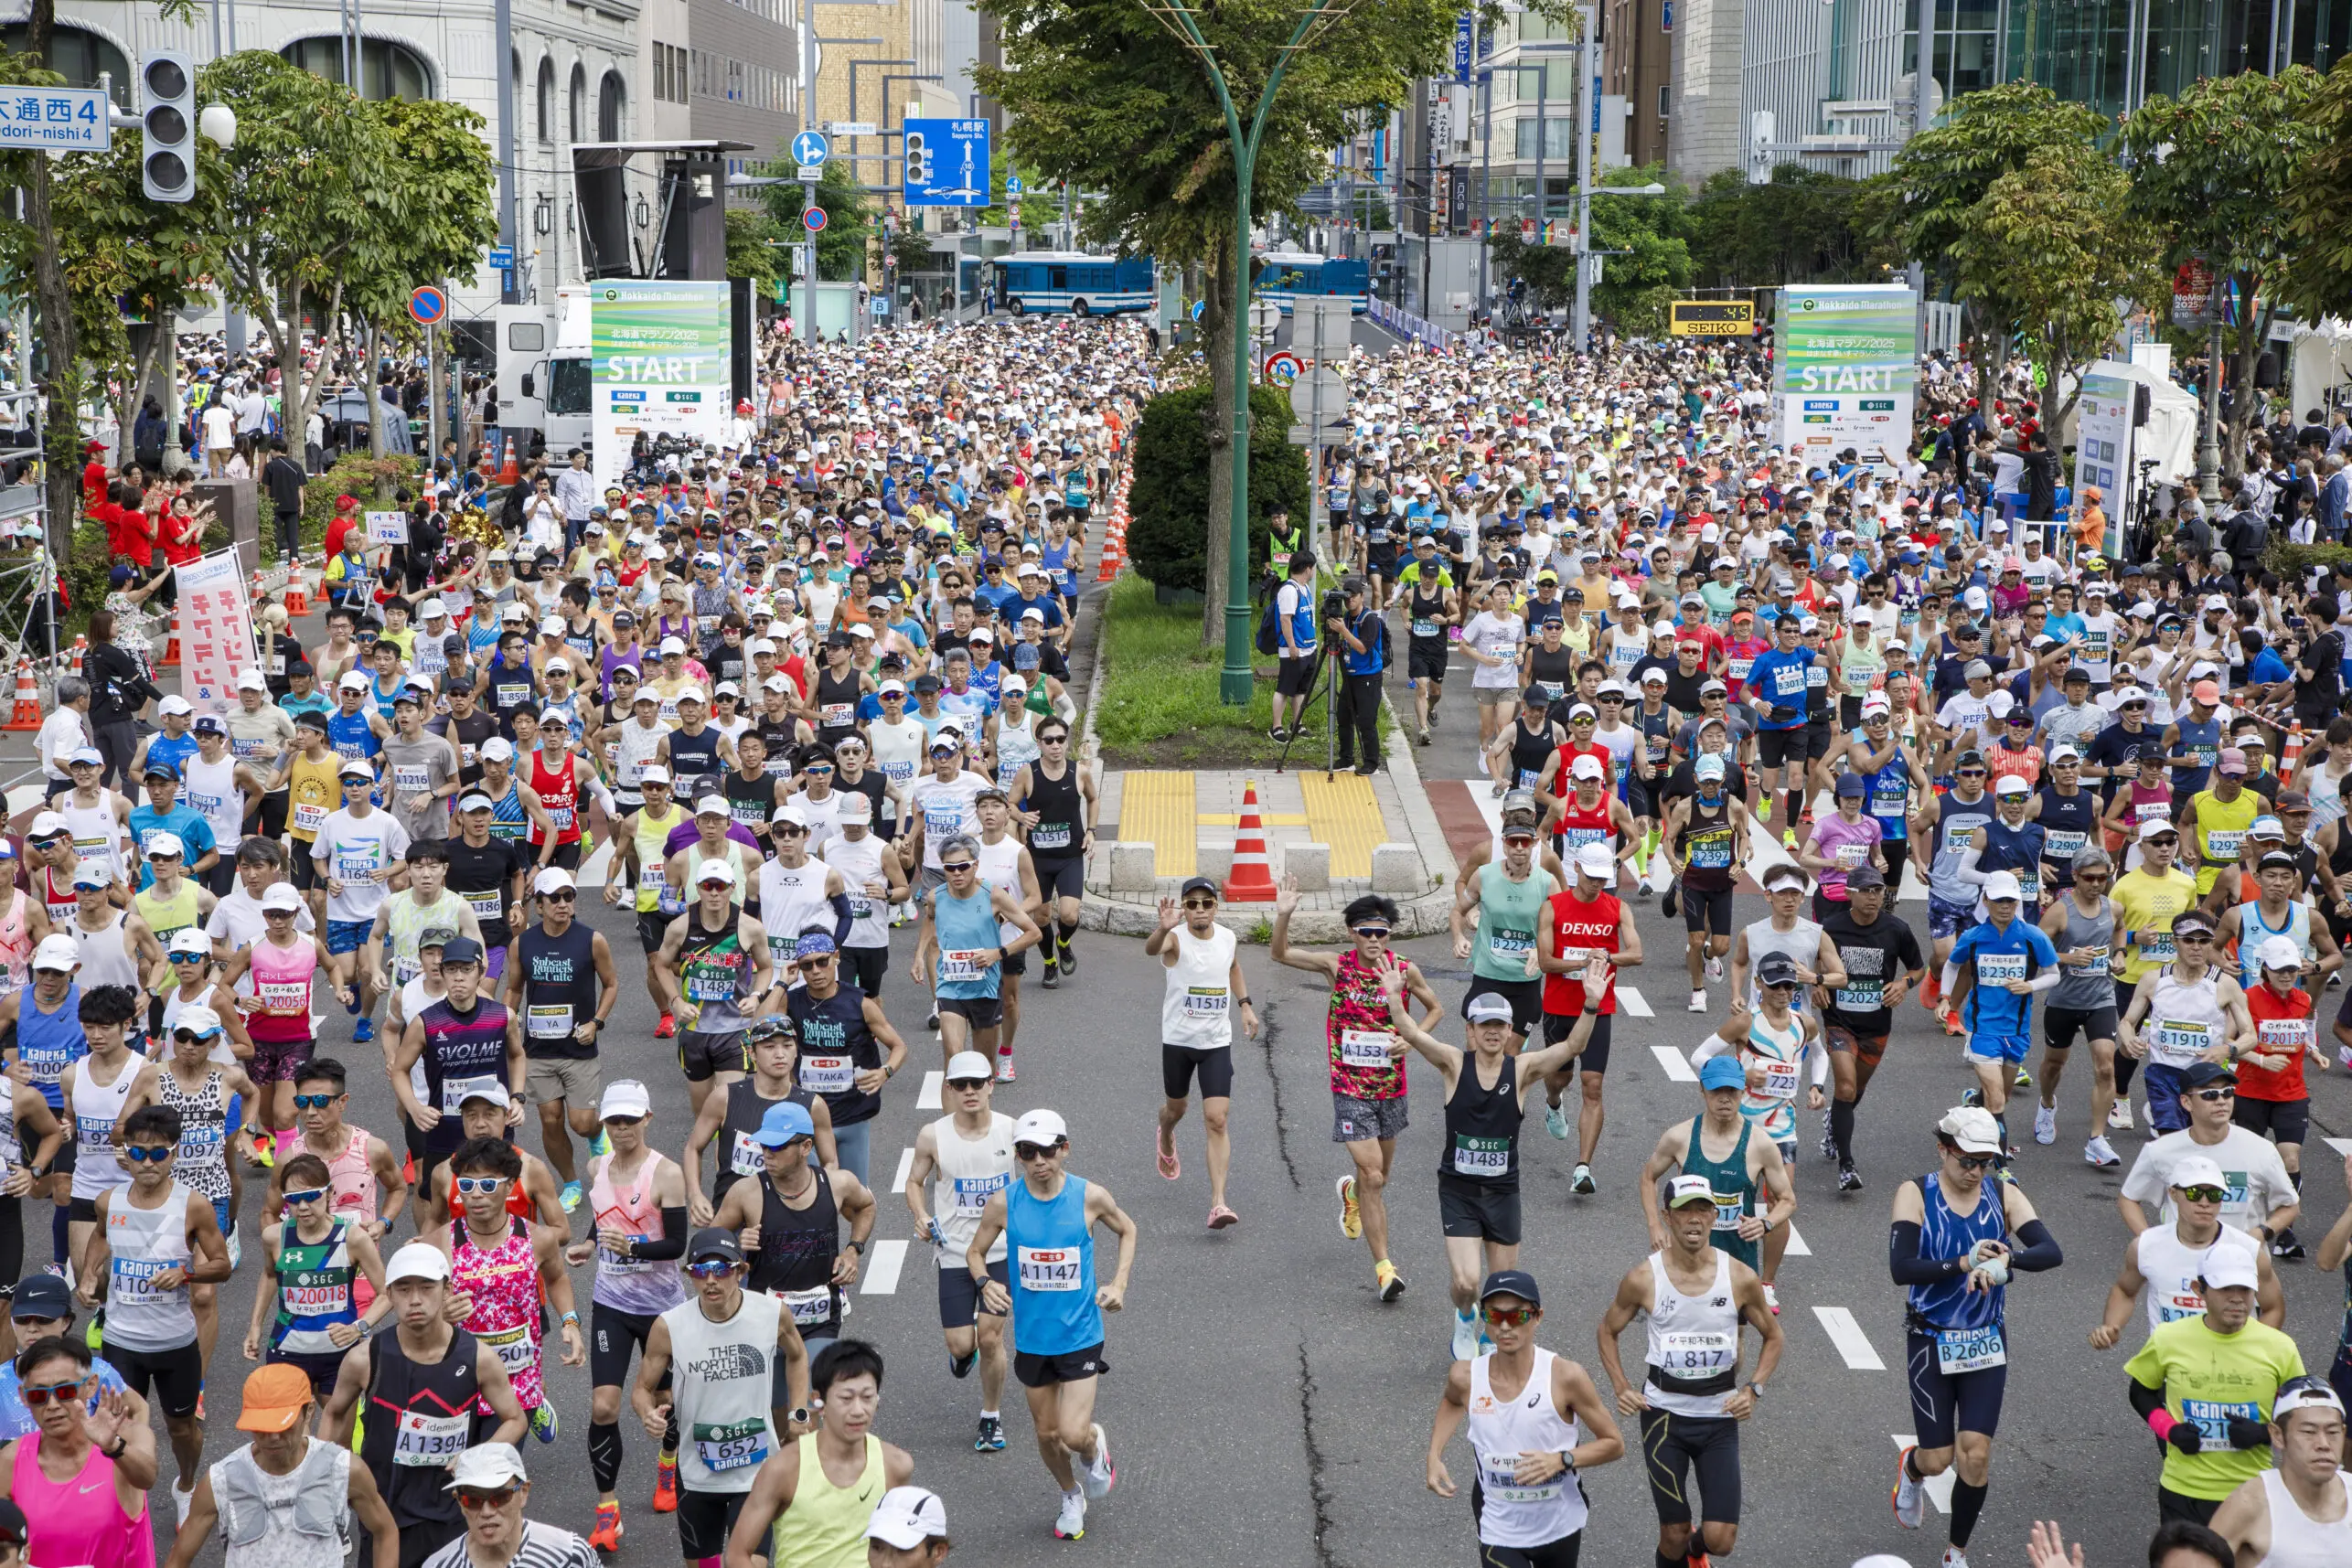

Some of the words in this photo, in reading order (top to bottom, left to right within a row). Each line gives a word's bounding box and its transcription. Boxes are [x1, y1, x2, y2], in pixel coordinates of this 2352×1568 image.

[0, 124, 80, 140] dori-nishi
[621, 291, 661, 301] Hokkaido
[663, 291, 704, 302] Marathon
[1819, 300, 1859, 310] Hokkaido
[1861, 300, 1902, 310] Marathon
[1687, 323, 1737, 334] SEIKO
[1807, 338, 1896, 348] 北海道マラソン2025
[608, 356, 704, 382] START
[1801, 366, 1898, 391] START
[77, 848, 111, 857] LARSSON
[1561, 922, 1613, 937] DENSO
[532, 955, 572, 968] Subcast
[711, 972, 726, 980] SGC
[1859, 981, 1875, 990] SGC
[1206, 987, 1227, 996] DEPO
[544, 1007, 567, 1015] DEPO
[547, 1019, 559, 1029] YA
[2181, 1023, 2207, 1032] DEPO
[437, 1040, 502, 1062] SVOLME
[818, 1072, 844, 1082] TAKA
[1481, 1140, 1499, 1150] SGC
[1033, 1253, 1063, 1262] 第一生命
[313, 1274, 334, 1284] SGC
[497, 1329, 525, 1345] DEPO
[1679, 1336, 1724, 1346] 平和不動産
[709, 1344, 737, 1358] THE
[1684, 1350, 1724, 1367] 817
[688, 1358, 740, 1373] NORTH
[703, 1368, 741, 1382] FACE
[727, 1424, 748, 1438] SGC
[718, 1436, 759, 1459] 652
